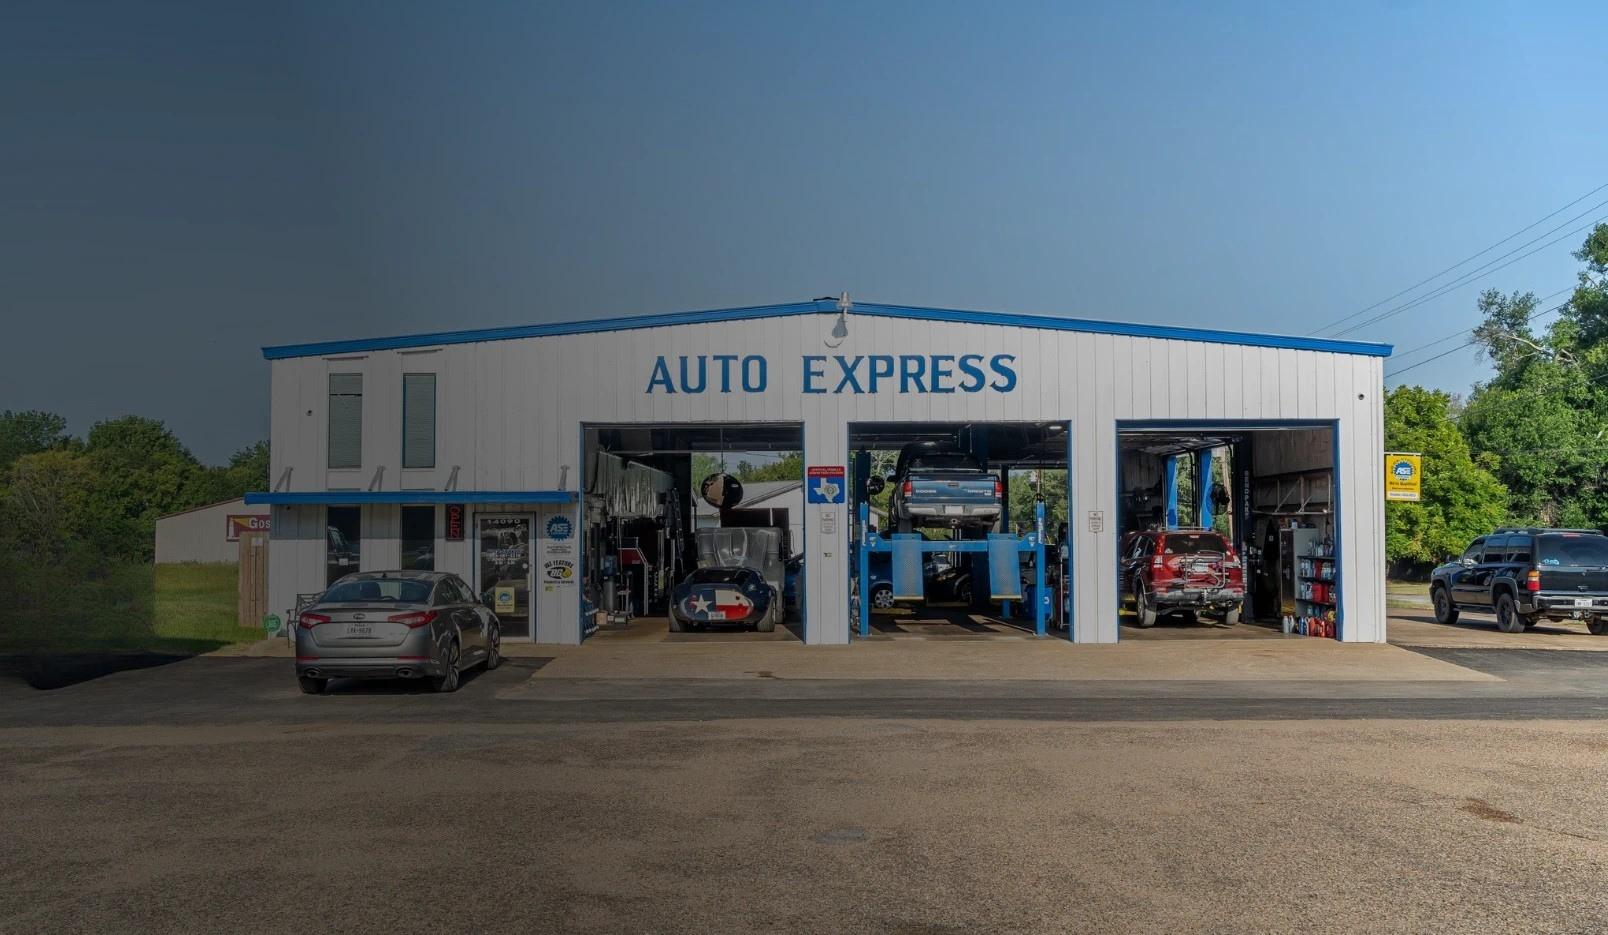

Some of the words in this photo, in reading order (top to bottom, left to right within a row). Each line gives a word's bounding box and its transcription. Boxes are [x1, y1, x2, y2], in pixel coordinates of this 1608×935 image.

[645, 355, 767, 394] AUTO
[802, 354, 1017, 394] EXPRESS
[1396, 467, 1411, 475] ASE
[550, 523, 569, 533] ASE
